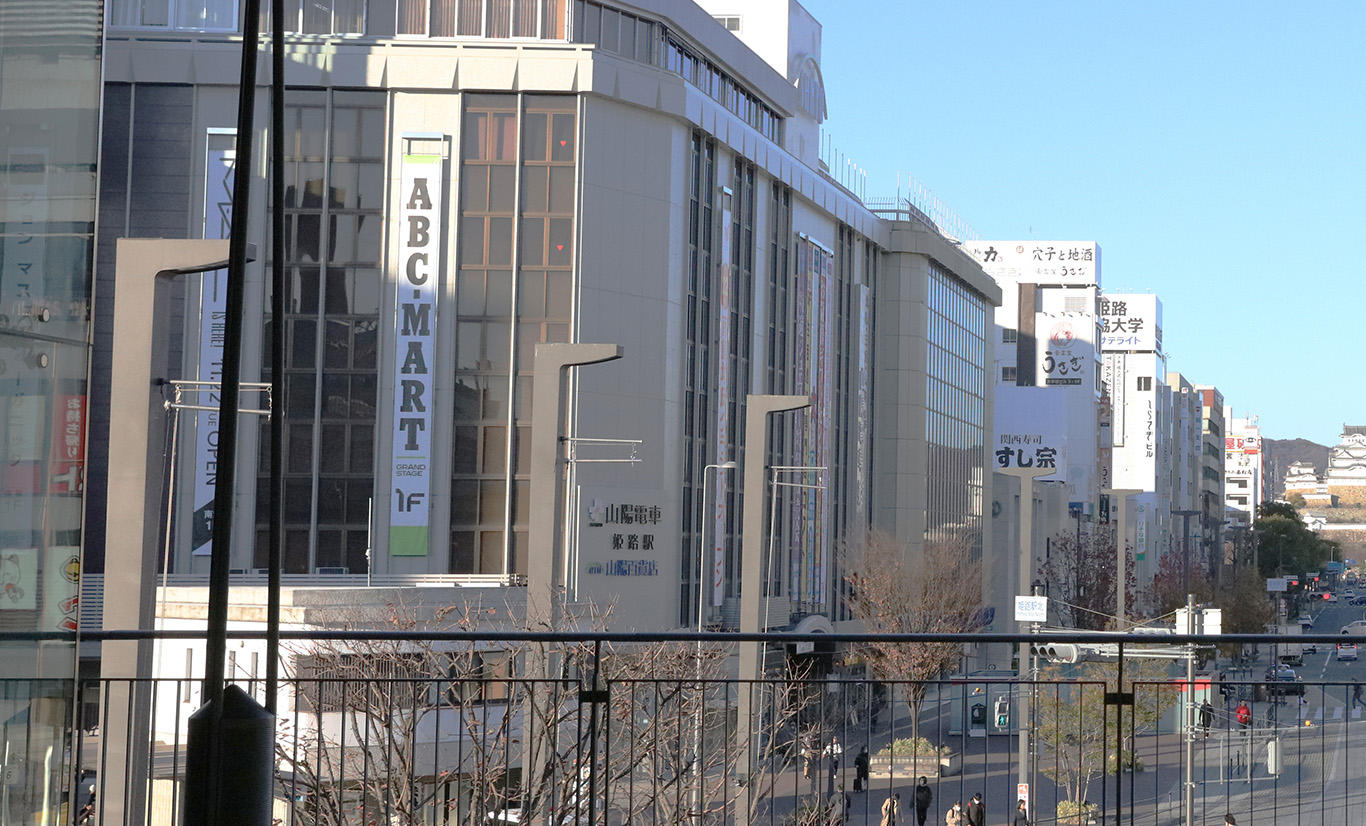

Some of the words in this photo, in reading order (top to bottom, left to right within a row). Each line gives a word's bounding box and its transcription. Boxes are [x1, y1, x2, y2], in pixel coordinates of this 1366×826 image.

[1032, 246, 1093, 261] 穴子と地酒
[1042, 351, 1084, 375] うさぎ
[1000, 434, 1042, 445] 関西寿司
[995, 447, 1057, 468] すし宗
[395, 488, 425, 512] 1F
[605, 504, 661, 525] 山陽電車
[612, 533, 654, 550] 姫路駅
[605, 560, 659, 576] 山陽百貨店
